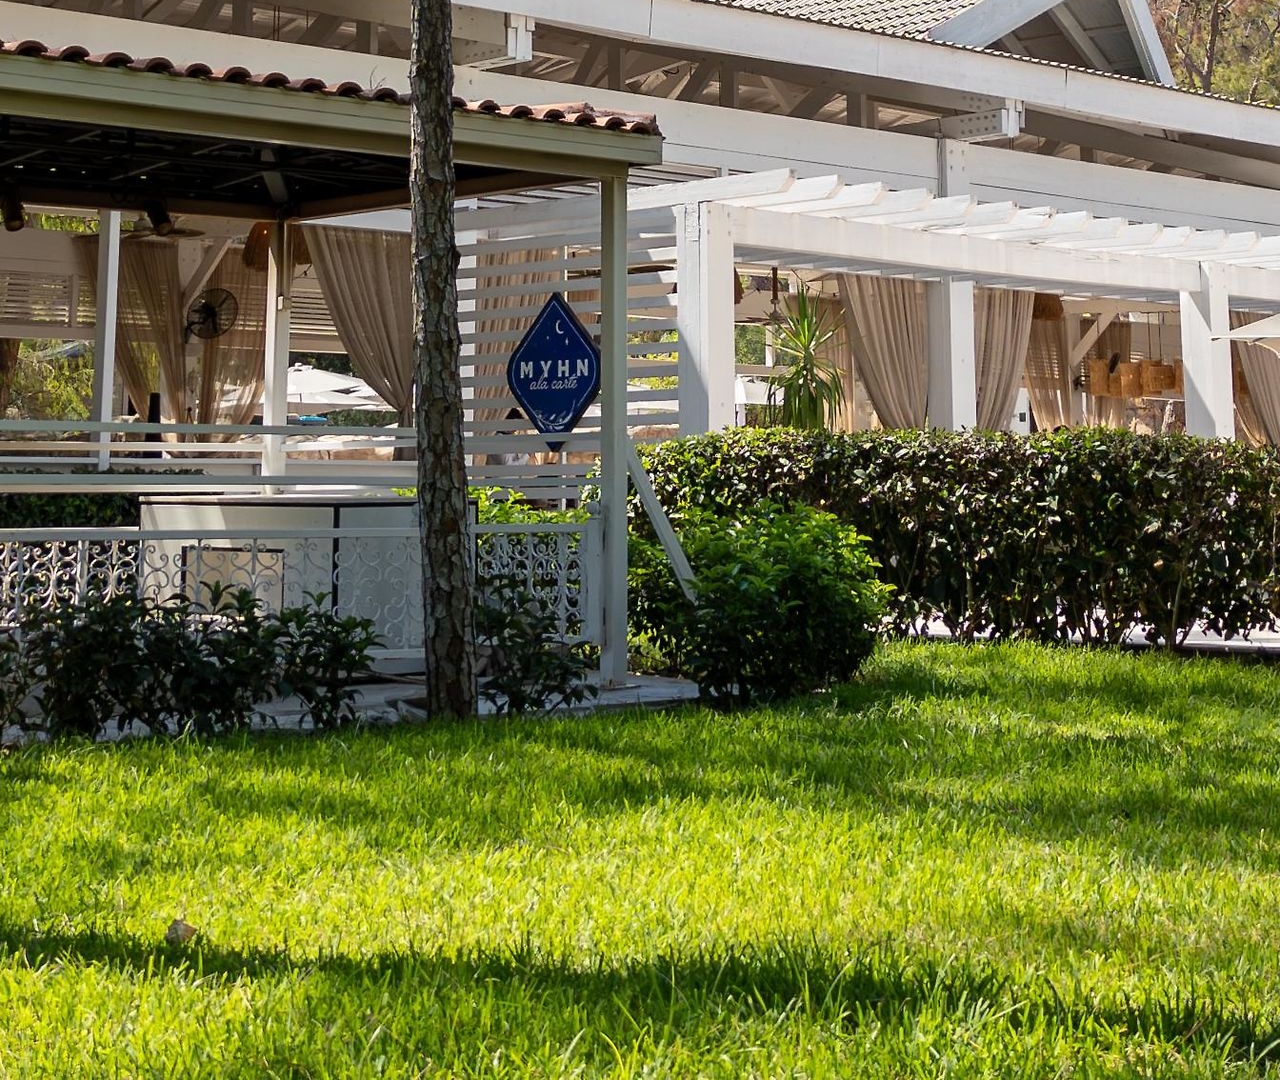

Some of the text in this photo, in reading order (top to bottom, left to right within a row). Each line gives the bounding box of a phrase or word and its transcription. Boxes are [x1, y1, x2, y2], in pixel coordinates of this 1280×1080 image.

[520, 358, 589, 379] MYHN
[530, 373, 578, 390] ala carte
